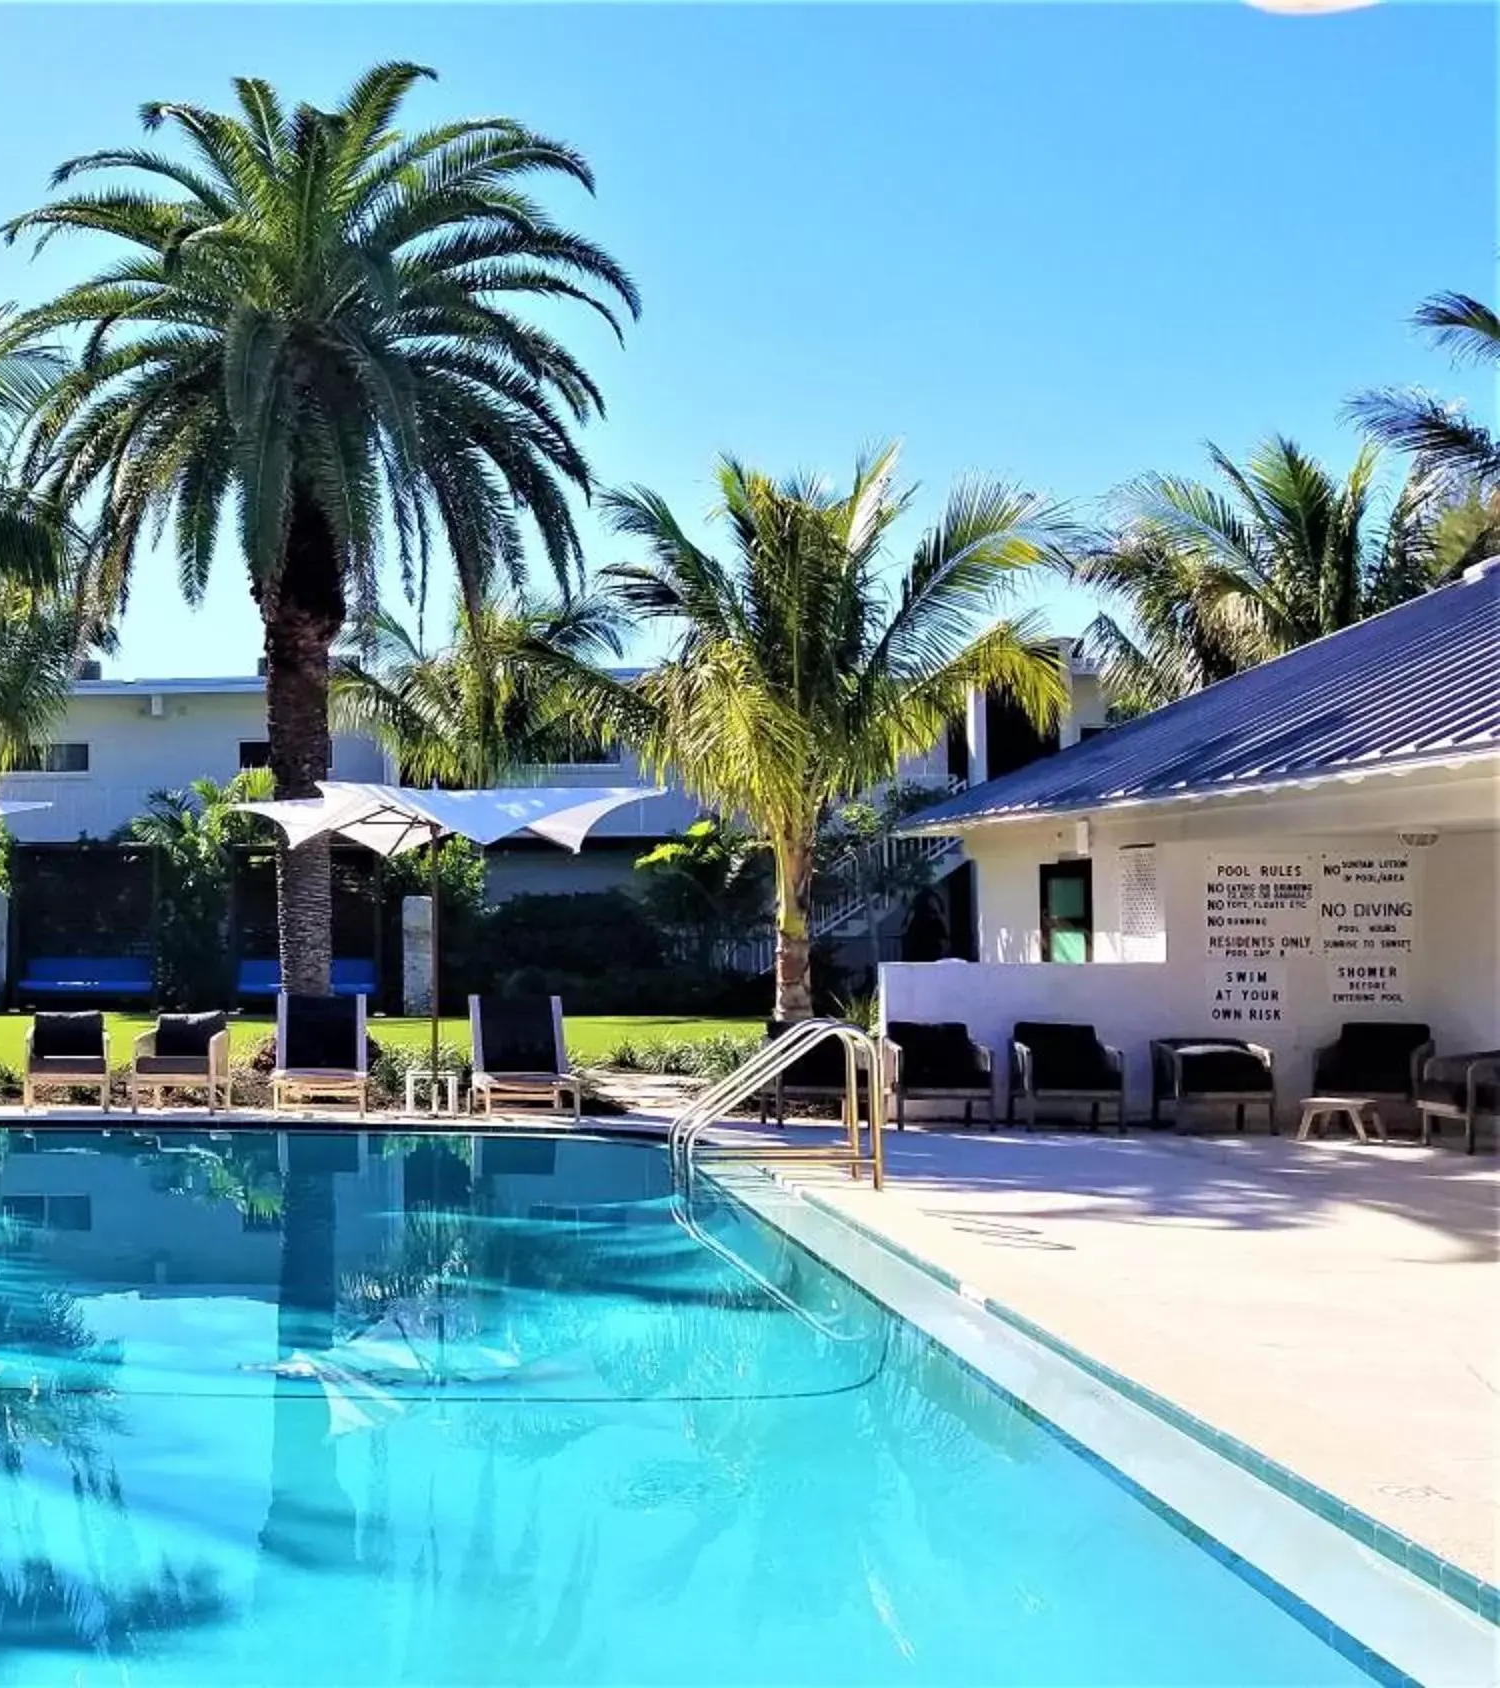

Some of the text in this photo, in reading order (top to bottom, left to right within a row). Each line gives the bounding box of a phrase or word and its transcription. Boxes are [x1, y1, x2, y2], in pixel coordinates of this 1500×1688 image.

[1217, 865, 1302, 877] POOL RULES
[1323, 865, 1341, 876] NO
[1207, 883, 1224, 893] NO
[1207, 900, 1224, 910] NO
[1321, 903, 1413, 917] NO DIVING
[1207, 916, 1224, 927] NO
[1209, 936, 1311, 948] RESIDENTS ONLY
[1363, 940, 1374, 948] TO
[1226, 972, 1267, 982] SWIM
[1338, 966, 1397, 978] SHOWER
[1215, 990, 1279, 1001] AT YOUR
[1381, 994, 1403, 1003] POOL
[1212, 1009, 1281, 1021] OWN RISK
